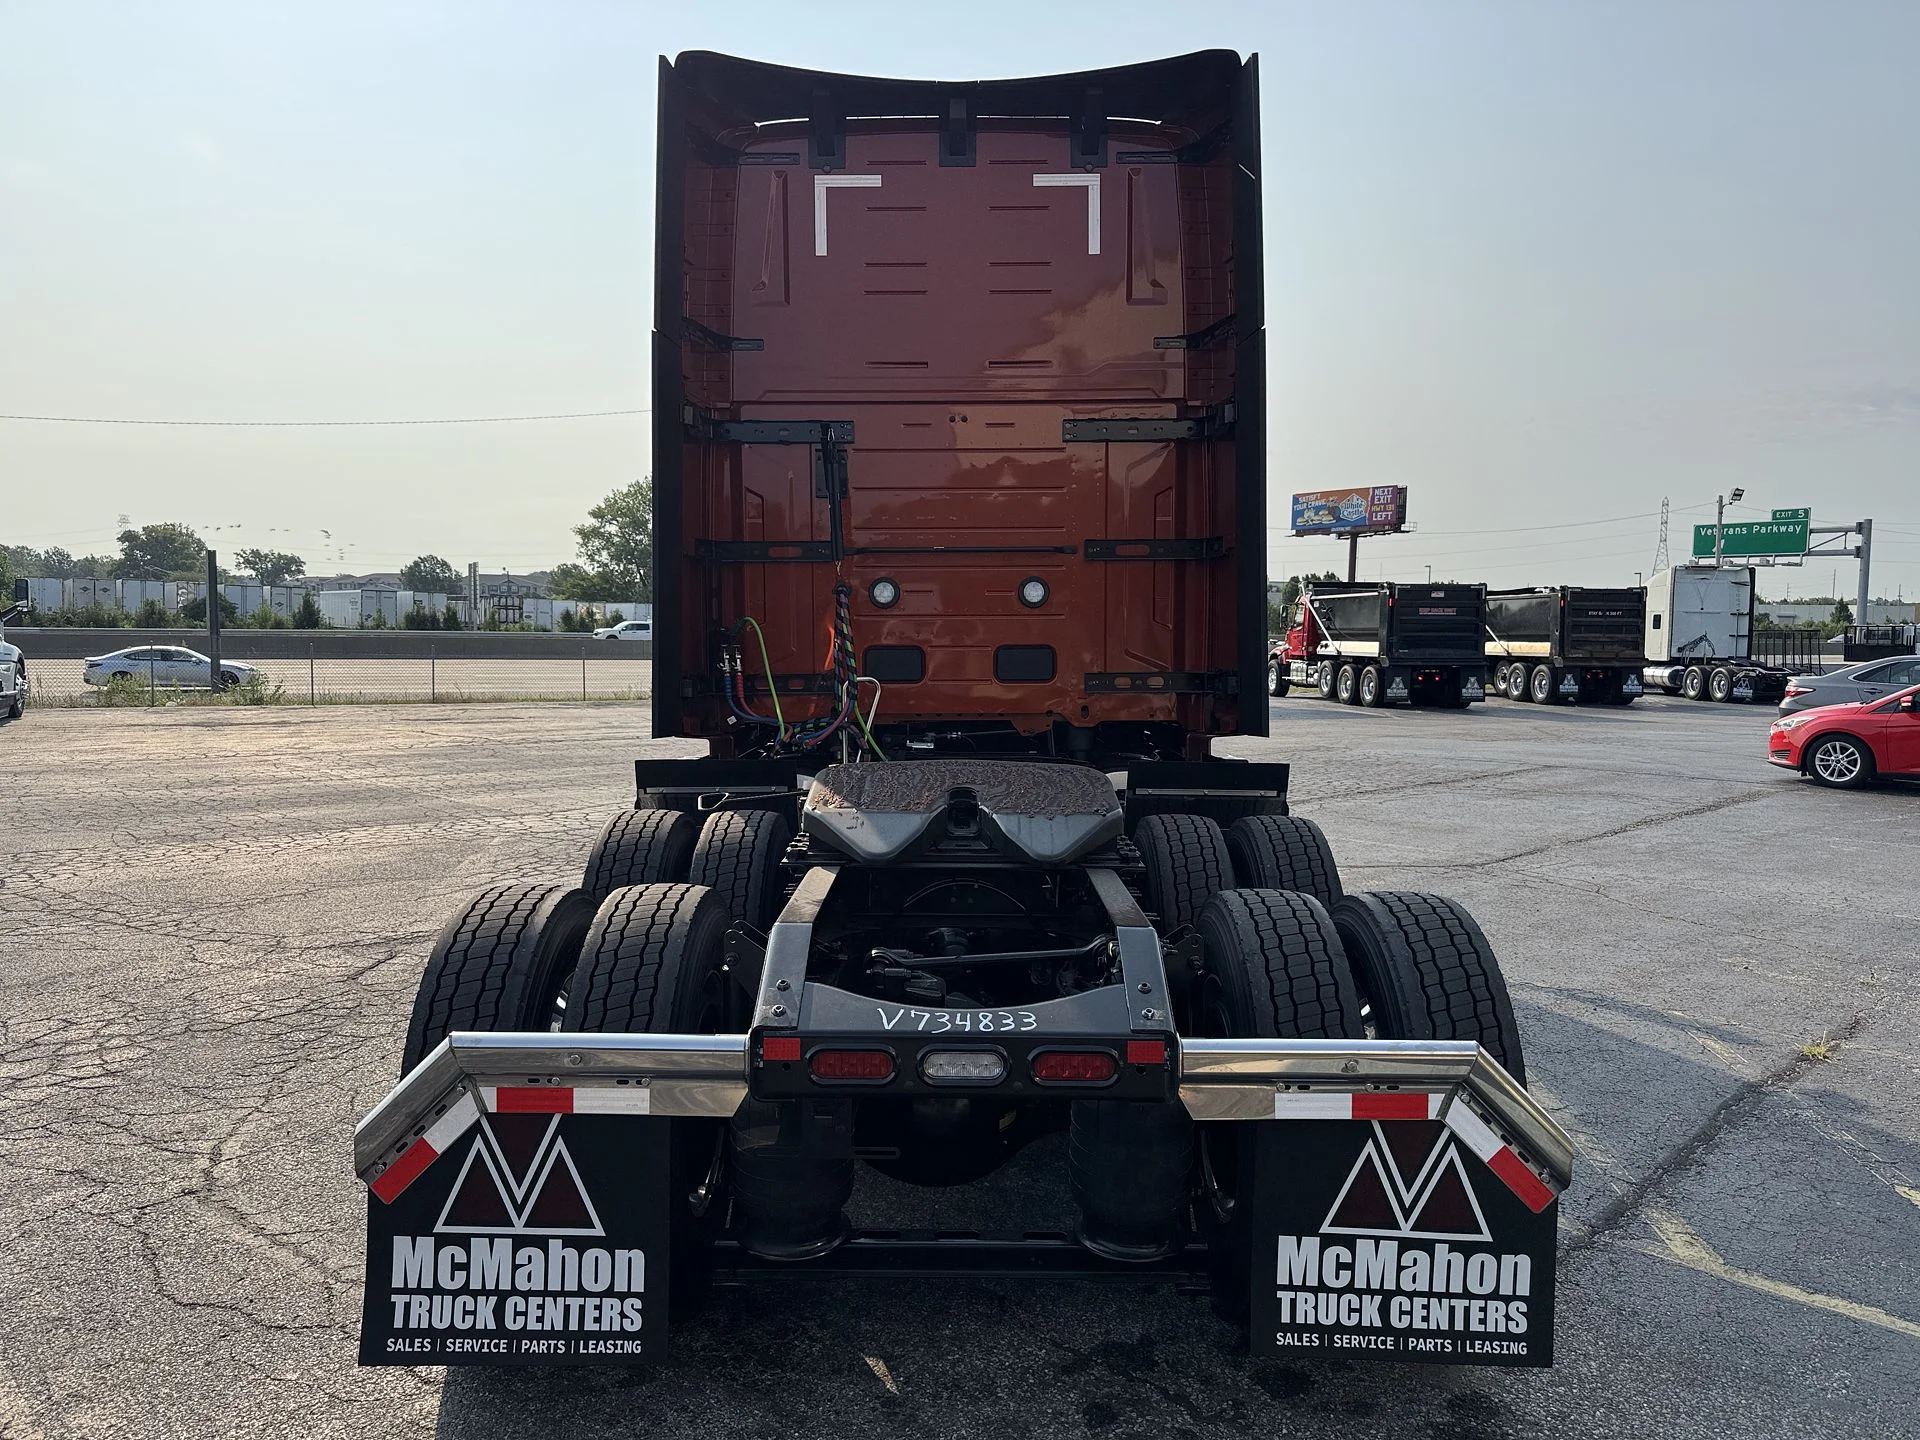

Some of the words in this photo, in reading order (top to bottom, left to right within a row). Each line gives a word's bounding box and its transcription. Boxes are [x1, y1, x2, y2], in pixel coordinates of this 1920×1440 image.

[1375, 487, 1393, 495] NEXT
[1294, 502, 1307, 511] YOUR
[1374, 495, 1392, 504] EXIT
[1373, 512, 1392, 520] LEFT
[1798, 509, 1805, 518] 5
[1700, 526, 1747, 536] Vetrans
[1753, 524, 1801, 534] Parkway
[391, 1235, 645, 1293] McMahon
[1276, 1235, 1531, 1296] McMahon
[391, 1294, 498, 1330] TRUCK
[504, 1296, 643, 1332] CENTERS
[1276, 1290, 1383, 1327] TRUCK
[1390, 1295, 1528, 1334] CENTERS
[386, 1338, 431, 1352] SALES
[445, 1339, 508, 1353] SERVICE
[521, 1340, 566, 1354] PARTS
[579, 1340, 642, 1354] LEASING
[1276, 1332, 1320, 1346] SALES
[1333, 1334, 1395, 1350] SERVICE
[1408, 1338, 1452, 1353] PARTS
[1466, 1340, 1528, 1355] LEASING
